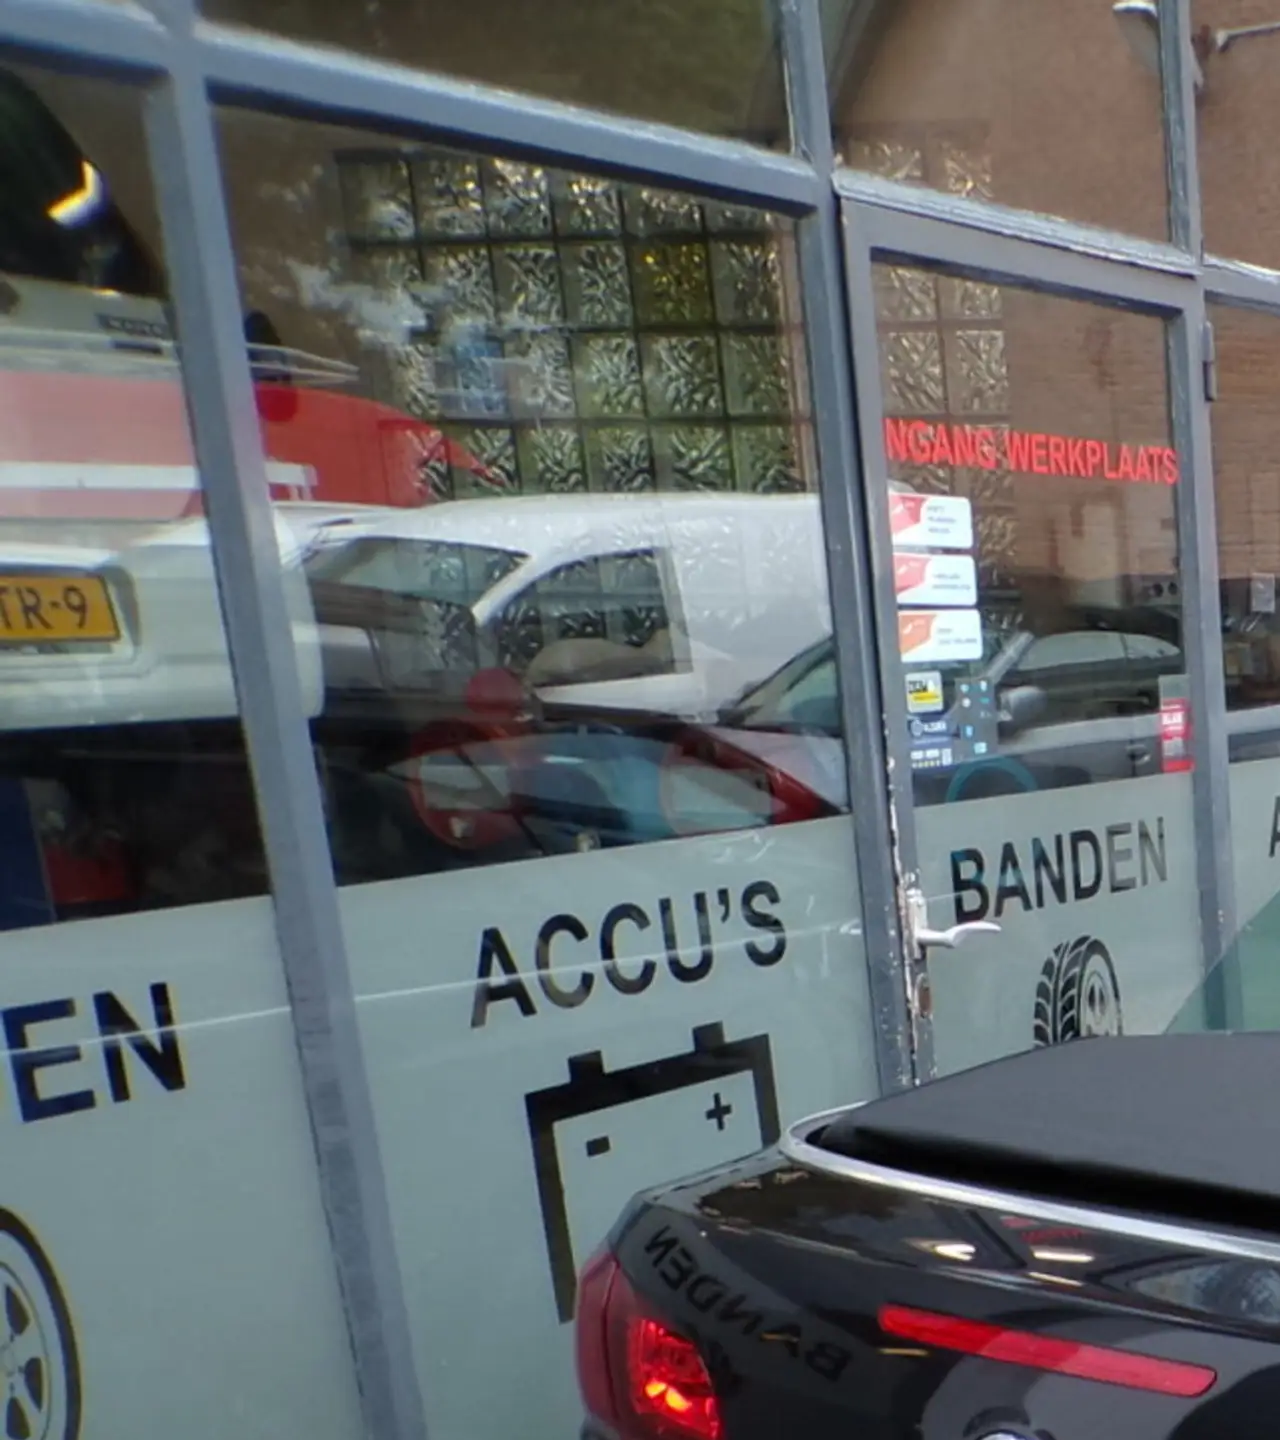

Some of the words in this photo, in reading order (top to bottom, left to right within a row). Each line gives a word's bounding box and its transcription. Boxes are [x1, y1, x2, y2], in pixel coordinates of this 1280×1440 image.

[884, 417, 997, 469] NGANG
[1006, 431, 1179, 485] WERKPLAATS
[950, 816, 1168, 925] BANDEN
[471, 881, 787, 1028] ACCU'S
